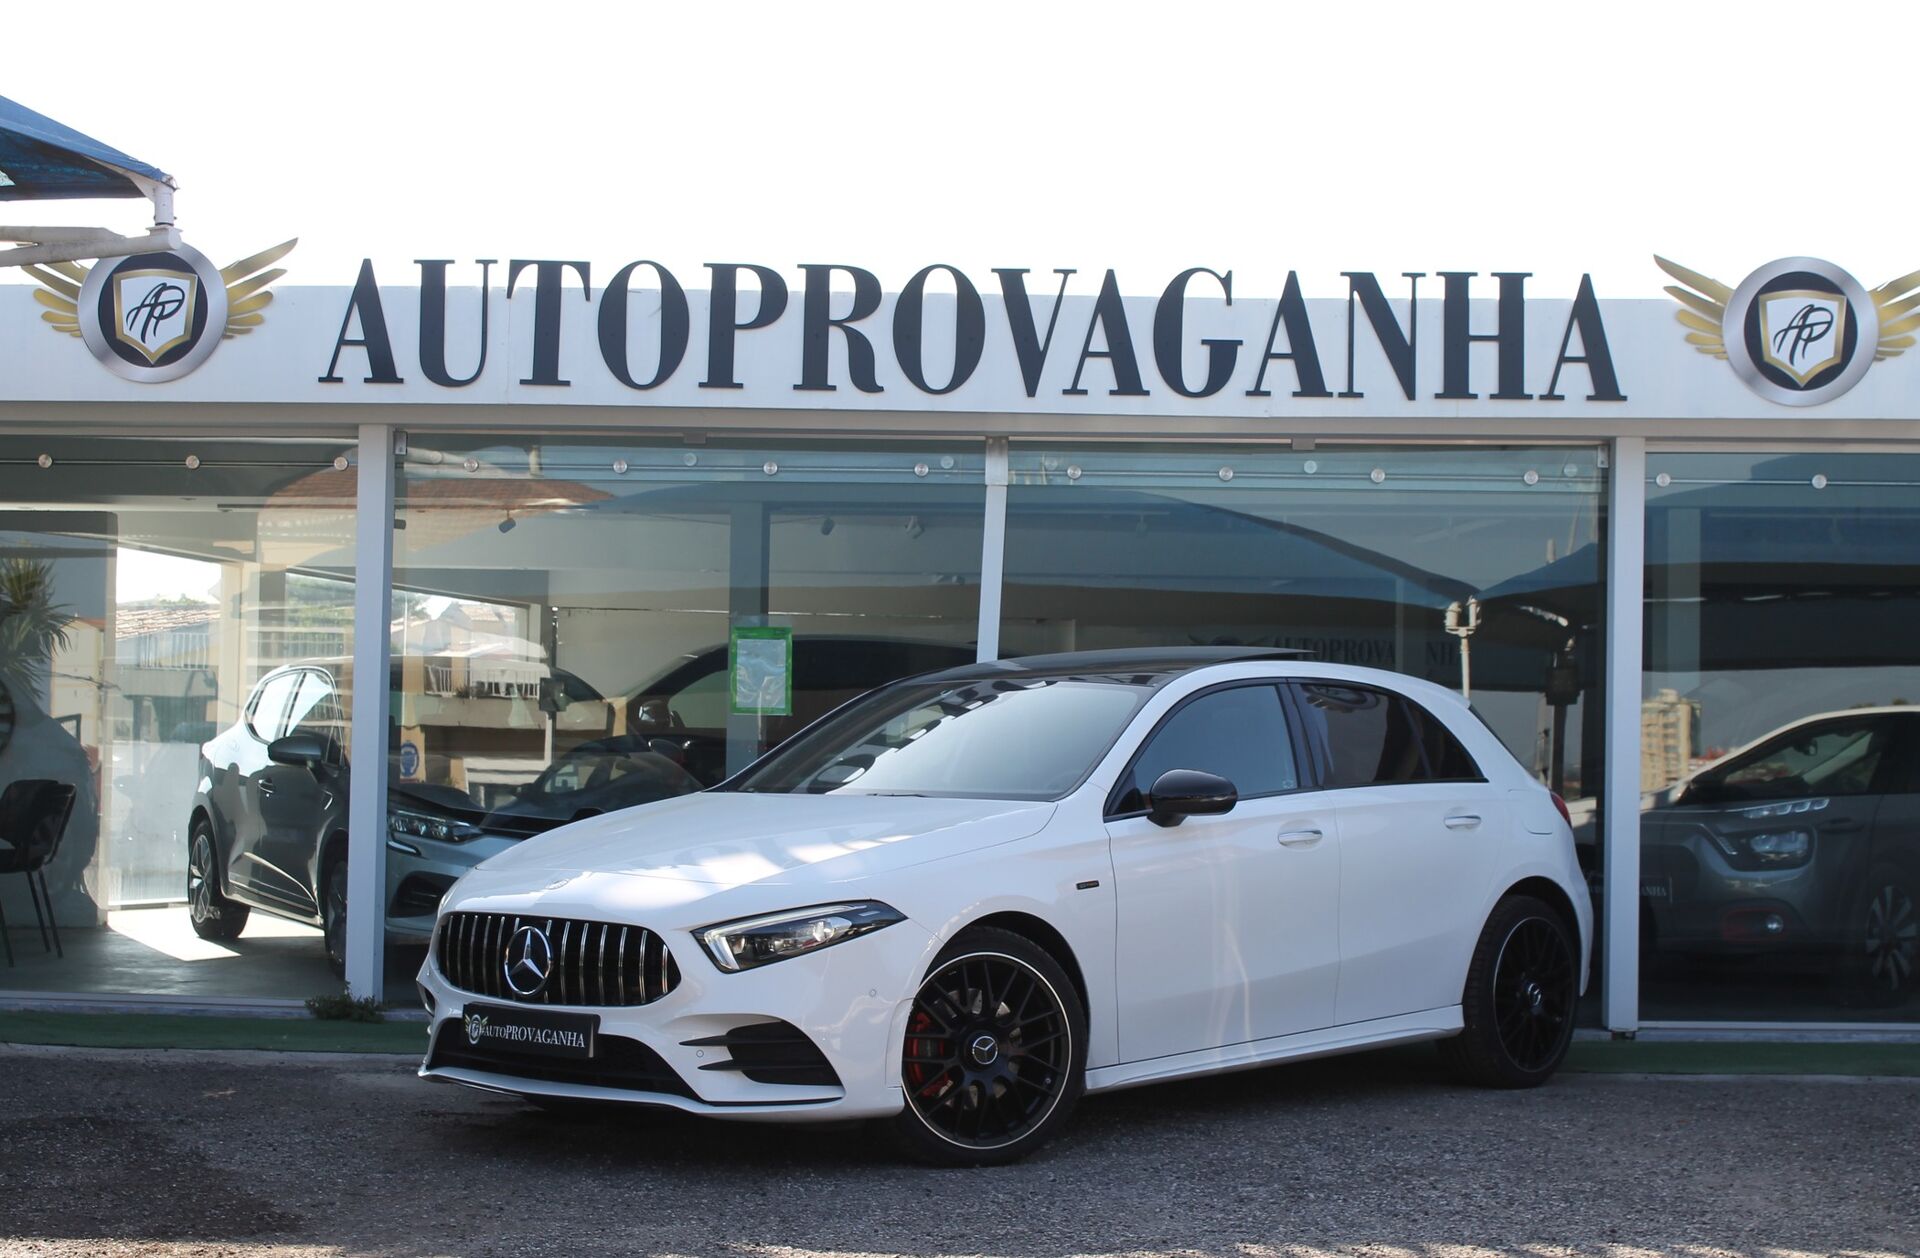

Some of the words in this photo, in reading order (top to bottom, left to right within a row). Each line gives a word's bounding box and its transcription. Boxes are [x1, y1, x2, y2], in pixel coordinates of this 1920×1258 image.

[126, 282, 185, 344] AP
[318, 258, 1627, 402] AUTOPROVAGANHA
[1774, 304, 1833, 366] AP
